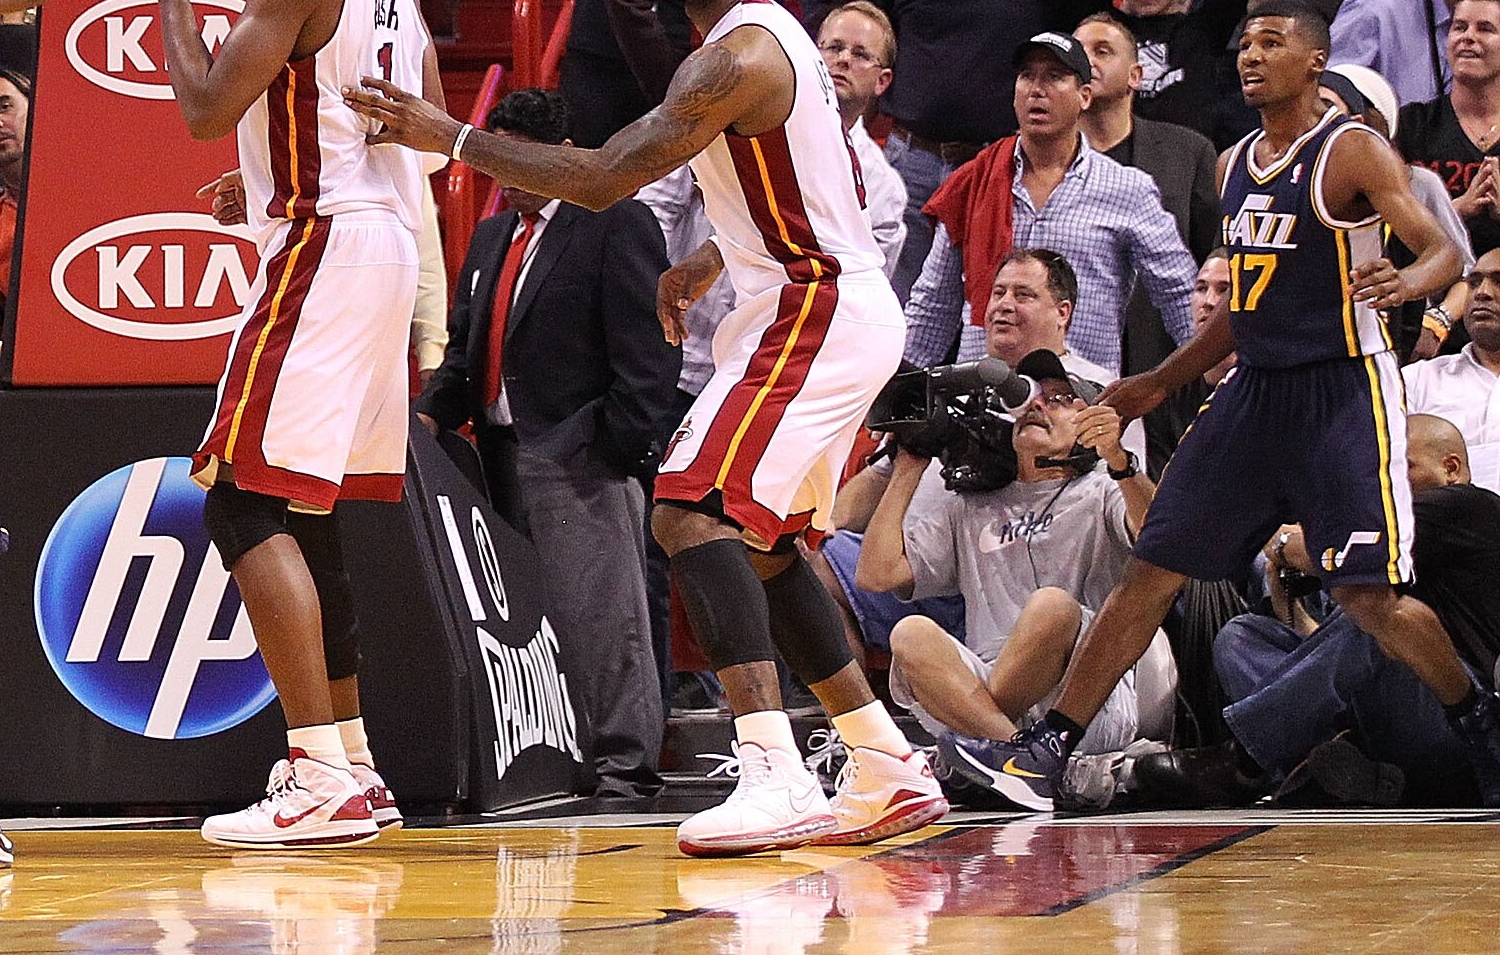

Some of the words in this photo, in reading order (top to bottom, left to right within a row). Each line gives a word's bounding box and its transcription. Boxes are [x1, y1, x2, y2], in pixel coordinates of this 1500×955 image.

[377, 42, 394, 101] 1
[1222, 193, 1298, 249] JAZZ
[96, 244, 251, 308] KIA
[1229, 253, 1278, 312] 17
[65, 457, 258, 740] hp
[476, 615, 583, 780] SPALDING
